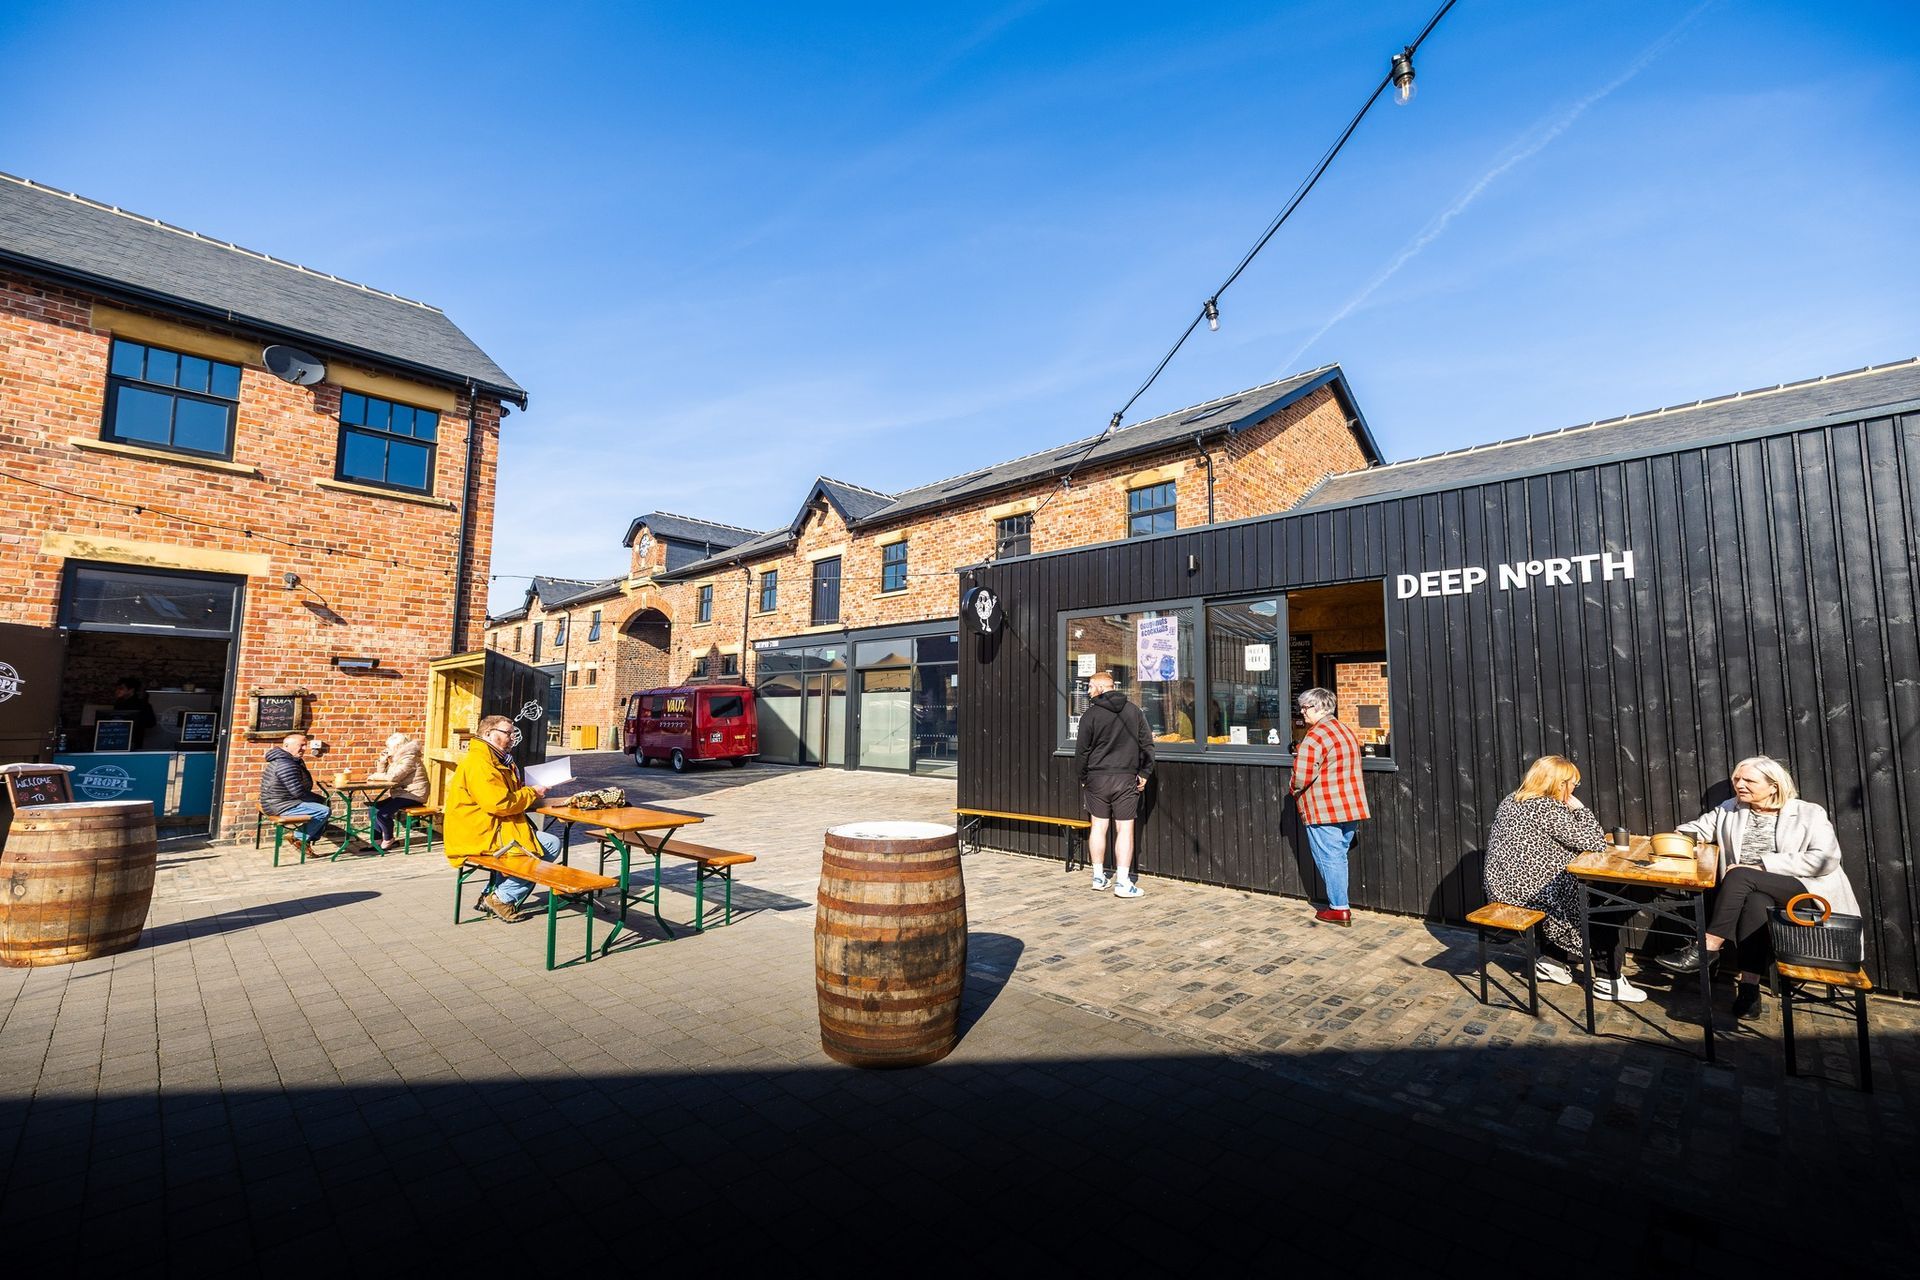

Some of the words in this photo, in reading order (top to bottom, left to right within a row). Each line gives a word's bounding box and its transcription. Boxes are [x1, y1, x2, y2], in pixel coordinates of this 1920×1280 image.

[1397, 567, 1487, 600] DEEP
[667, 699, 687, 713] VAUX
[15, 776, 53, 789] WELCOME
[82, 776, 128, 789] PROPA
[31, 793, 46, 802] TO
